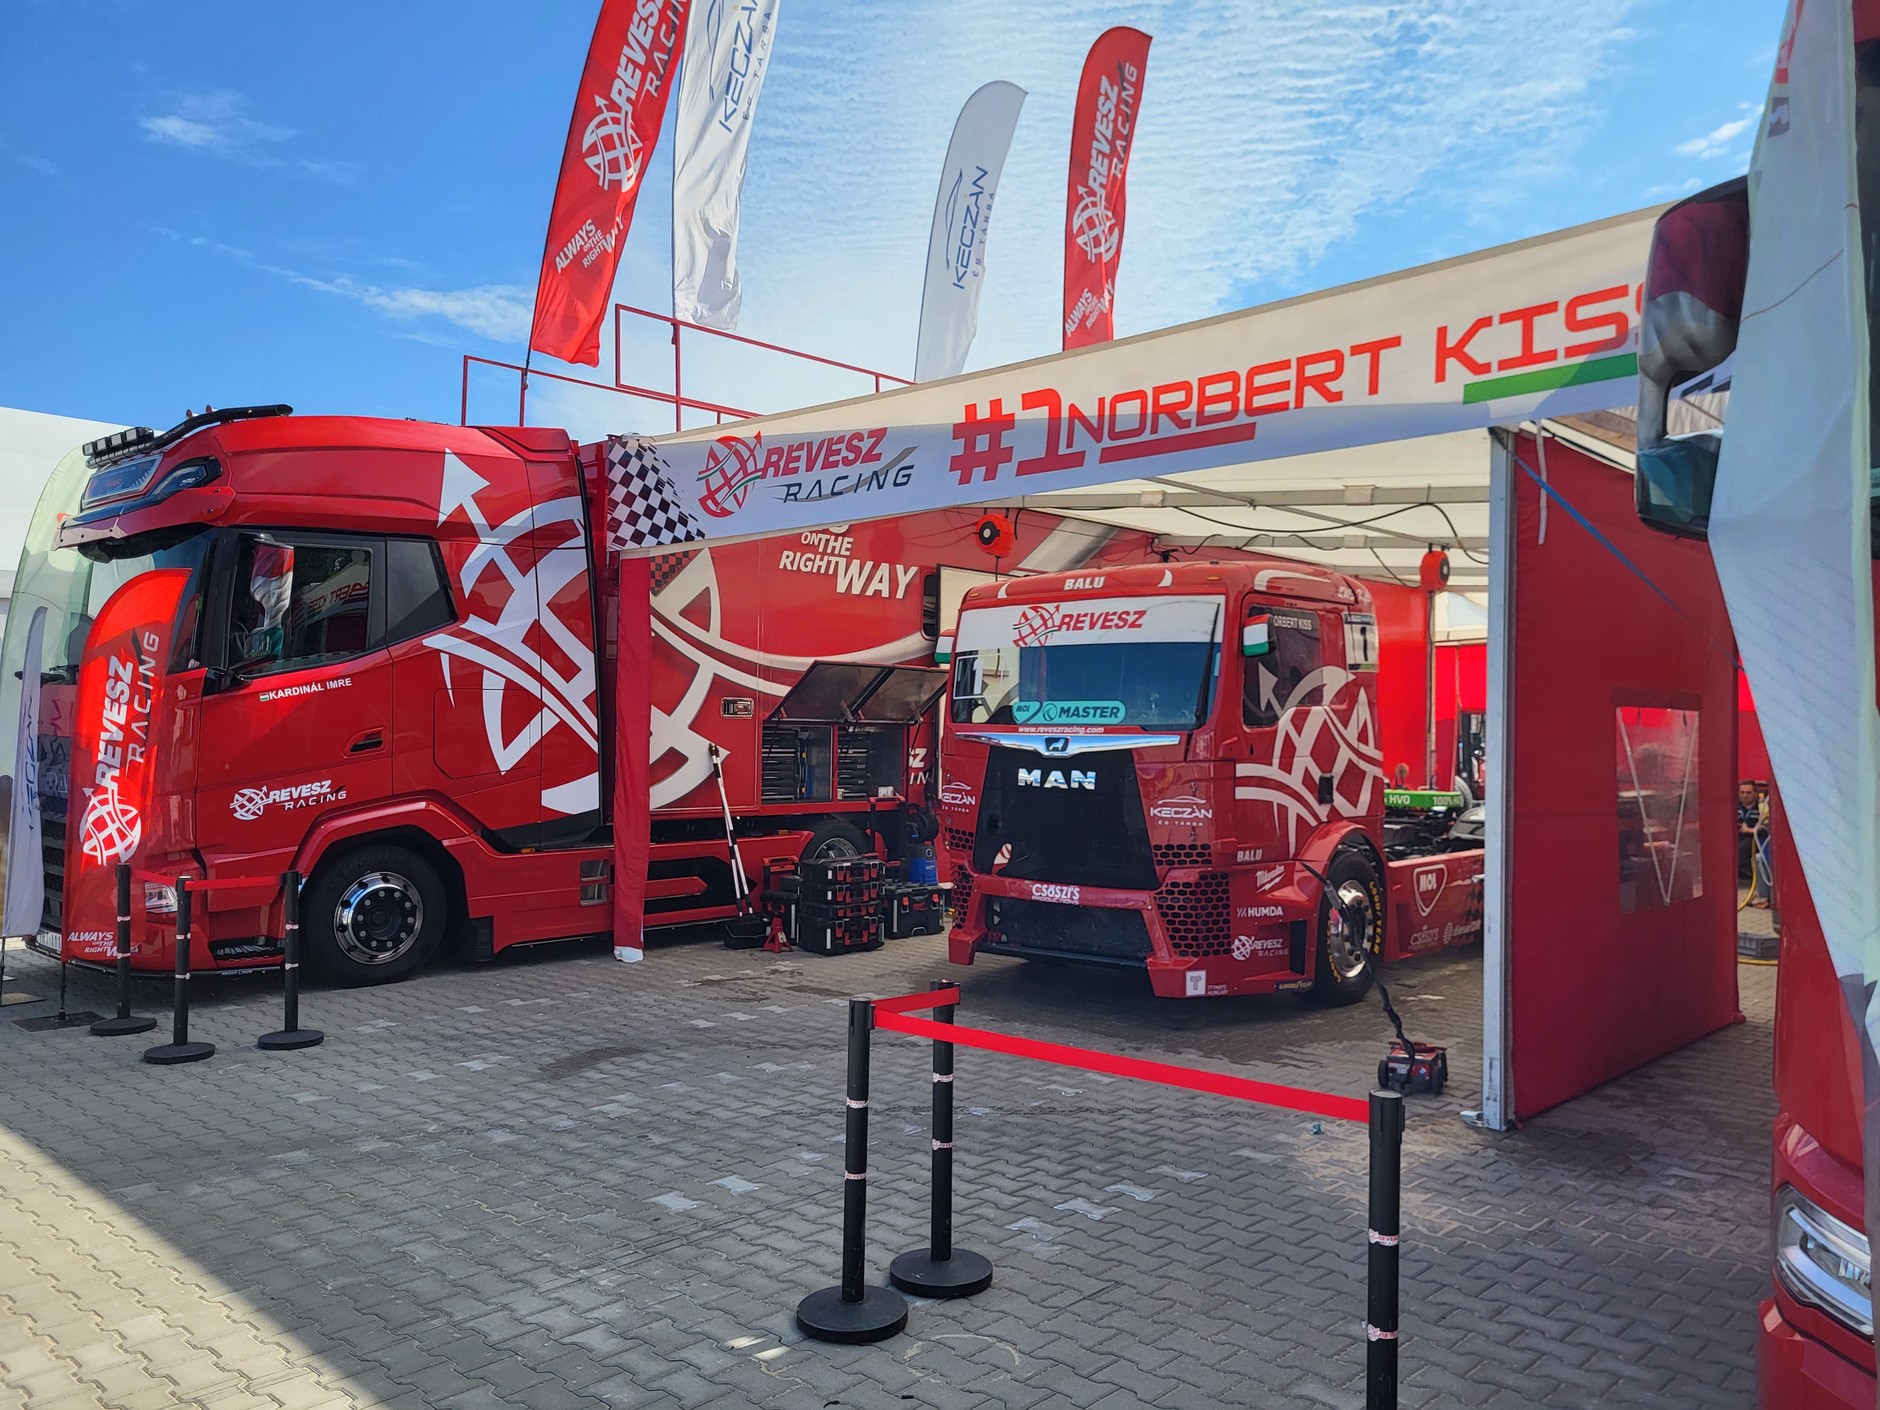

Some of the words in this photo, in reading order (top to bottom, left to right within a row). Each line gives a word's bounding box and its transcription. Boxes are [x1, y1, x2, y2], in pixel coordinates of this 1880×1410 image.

[610, 0, 664, 112] REVES
[1112, 62, 1138, 179] RACING
[555, 218, 596, 274] ALWAYS
[582, 239, 608, 268] RIGHT
[1435, 284, 1646, 383] KIS
[780, 464, 915, 504] RACING
[801, 531, 821, 546] ON
[817, 534, 854, 556] THE
[779, 550, 844, 575] RIGHT
[836, 555, 919, 599] WAY
[1063, 576, 1105, 591] BALU
[1058, 610, 1147, 632] REVESZ
[1273, 615, 1298, 629] ORBERT
[973, 657, 984, 695] 1
[127, 631, 160, 764] RACING
[269, 682, 325, 700] KARDINÁL
[326, 678, 353, 690] IMRE
[95, 655, 134, 788] REVESZ
[1058, 706, 1120, 719] MASTER
[1017, 768, 1096, 790] MAN
[269, 780, 331, 803] REVESZ
[284, 790, 347, 811] RACING
[1389, 794, 1411, 804] HVO
[1237, 848, 1263, 862] BALU
[1247, 906, 1284, 917] HUMDA
[67, 931, 115, 941] ALWAYS
[1257, 948, 1290, 958] RACING
